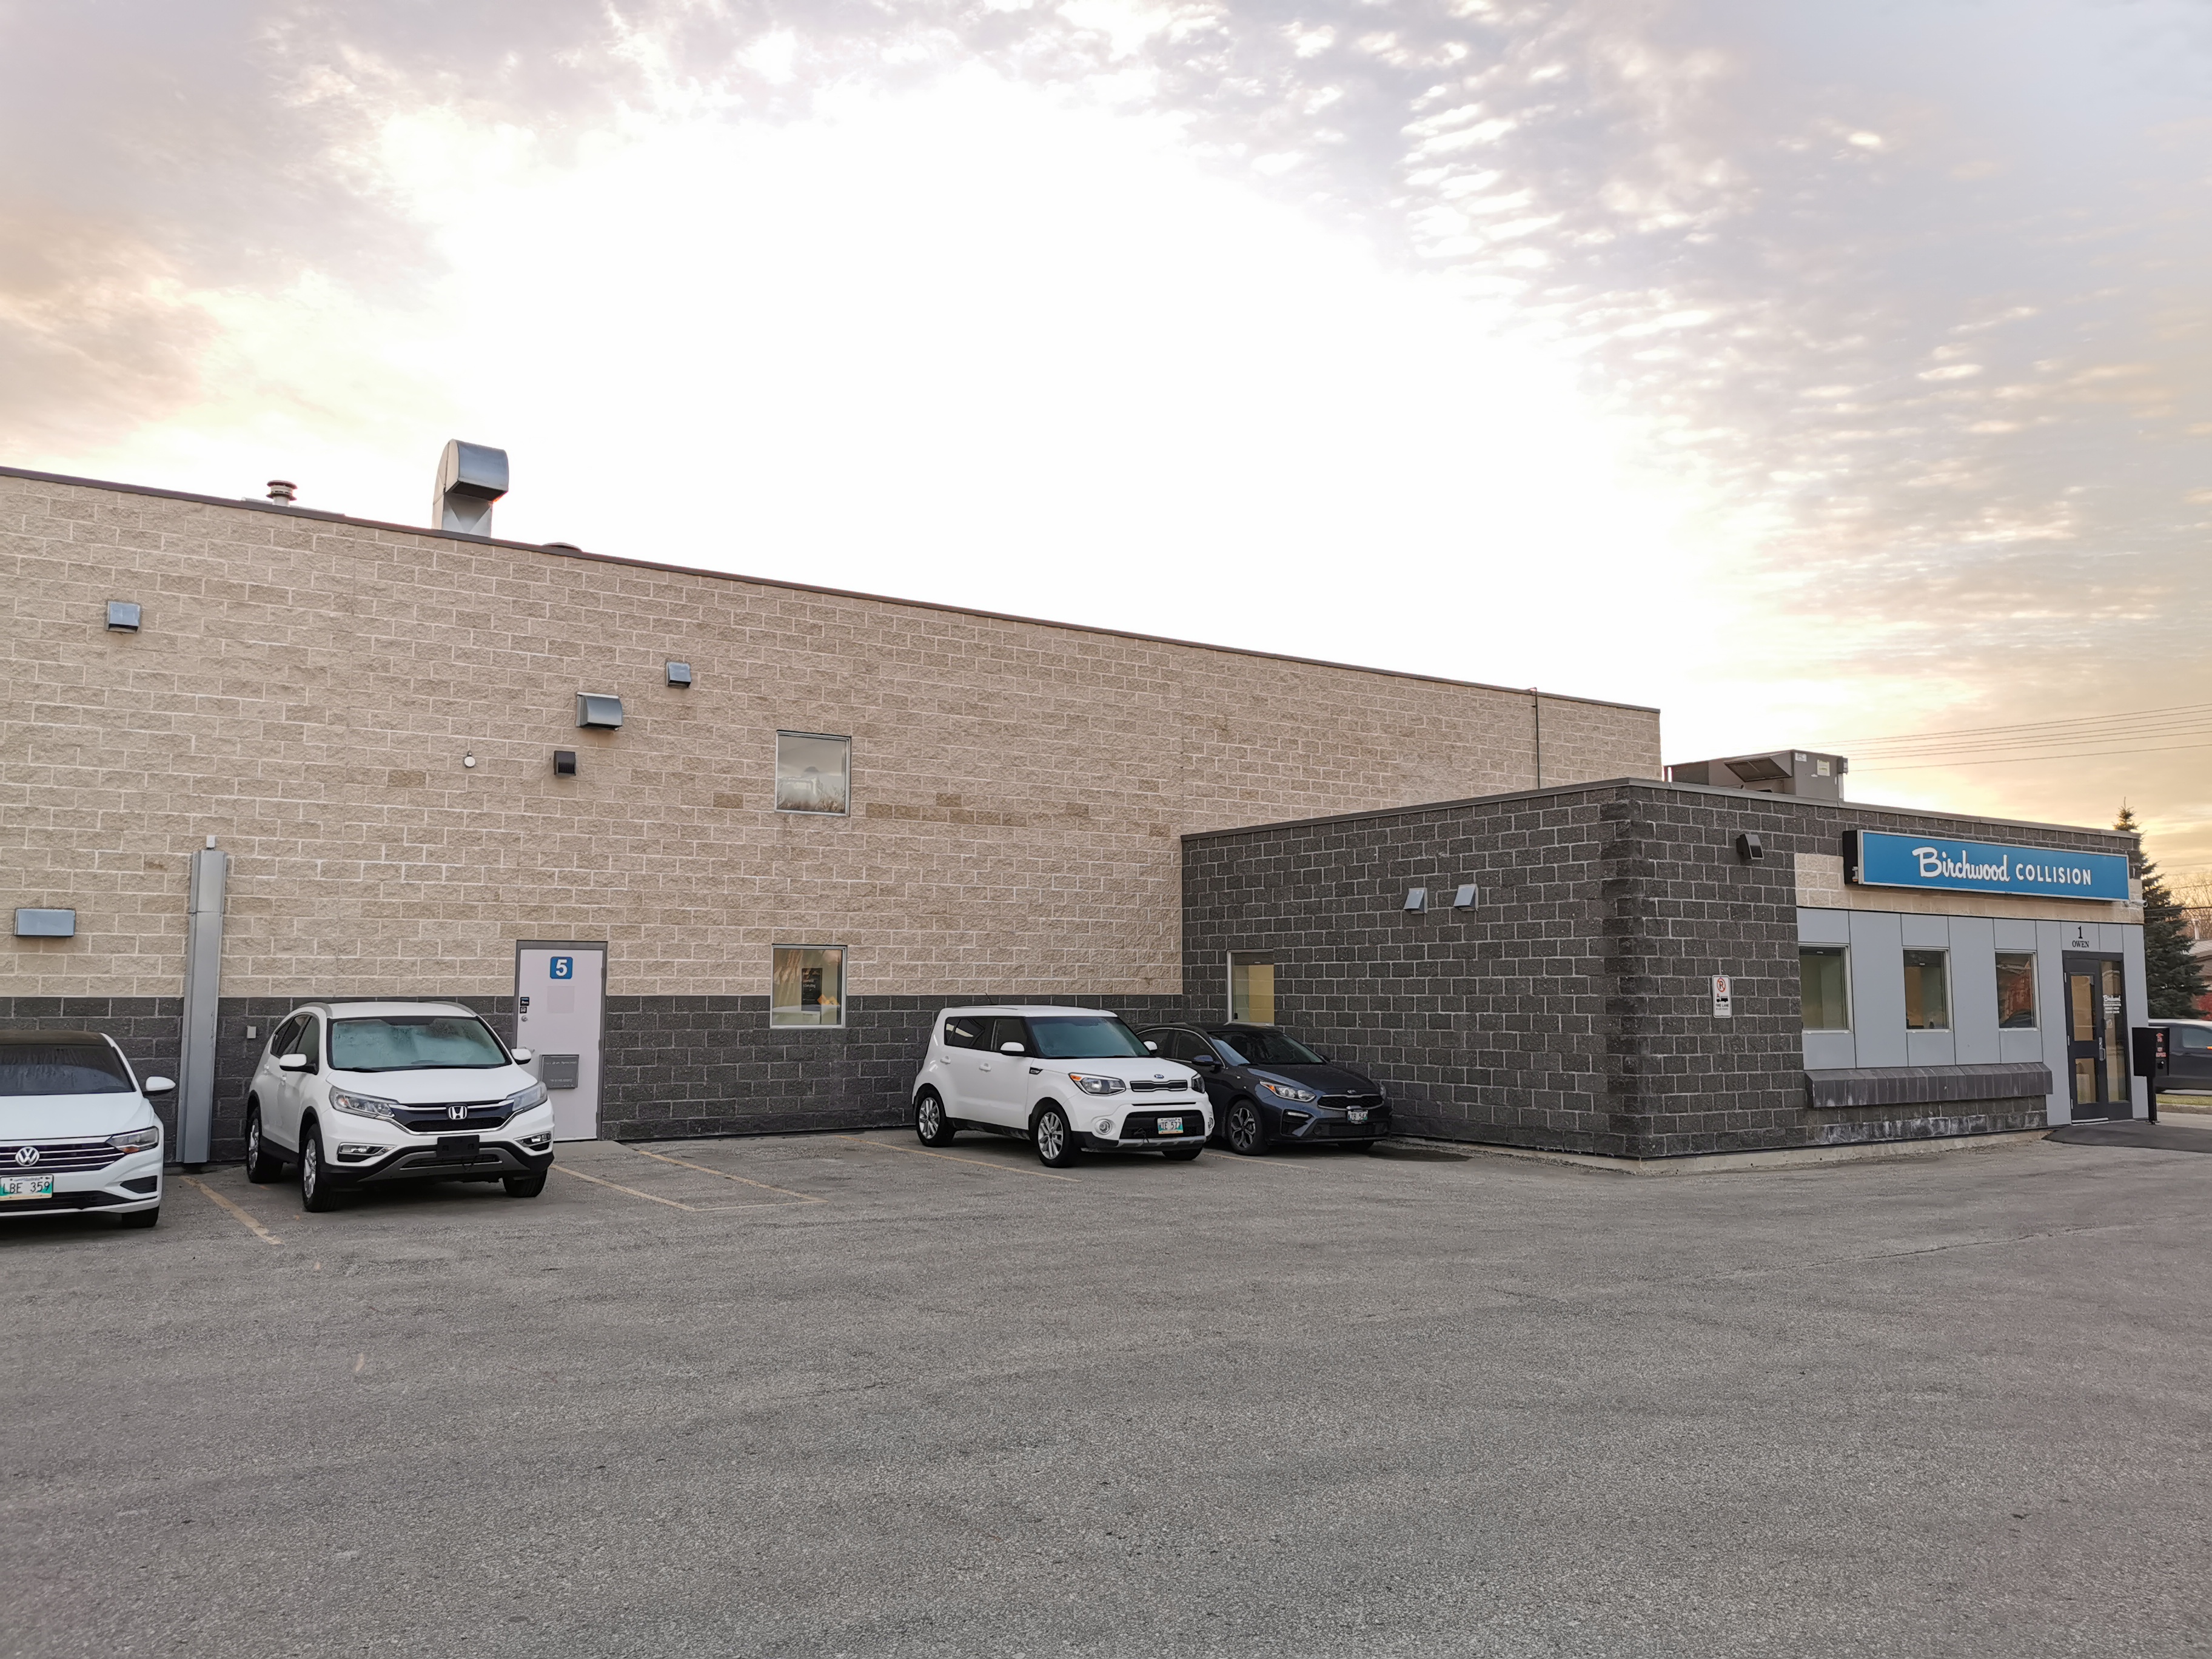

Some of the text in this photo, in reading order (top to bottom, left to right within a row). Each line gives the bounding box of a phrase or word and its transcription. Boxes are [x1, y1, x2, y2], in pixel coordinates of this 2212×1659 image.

[1912, 846, 2092, 886] Birchwood COLLISION
[2077, 925, 2083, 939] 1
[555, 959, 568, 976] 5
[3, 1181, 50, 1194] LBE 359
